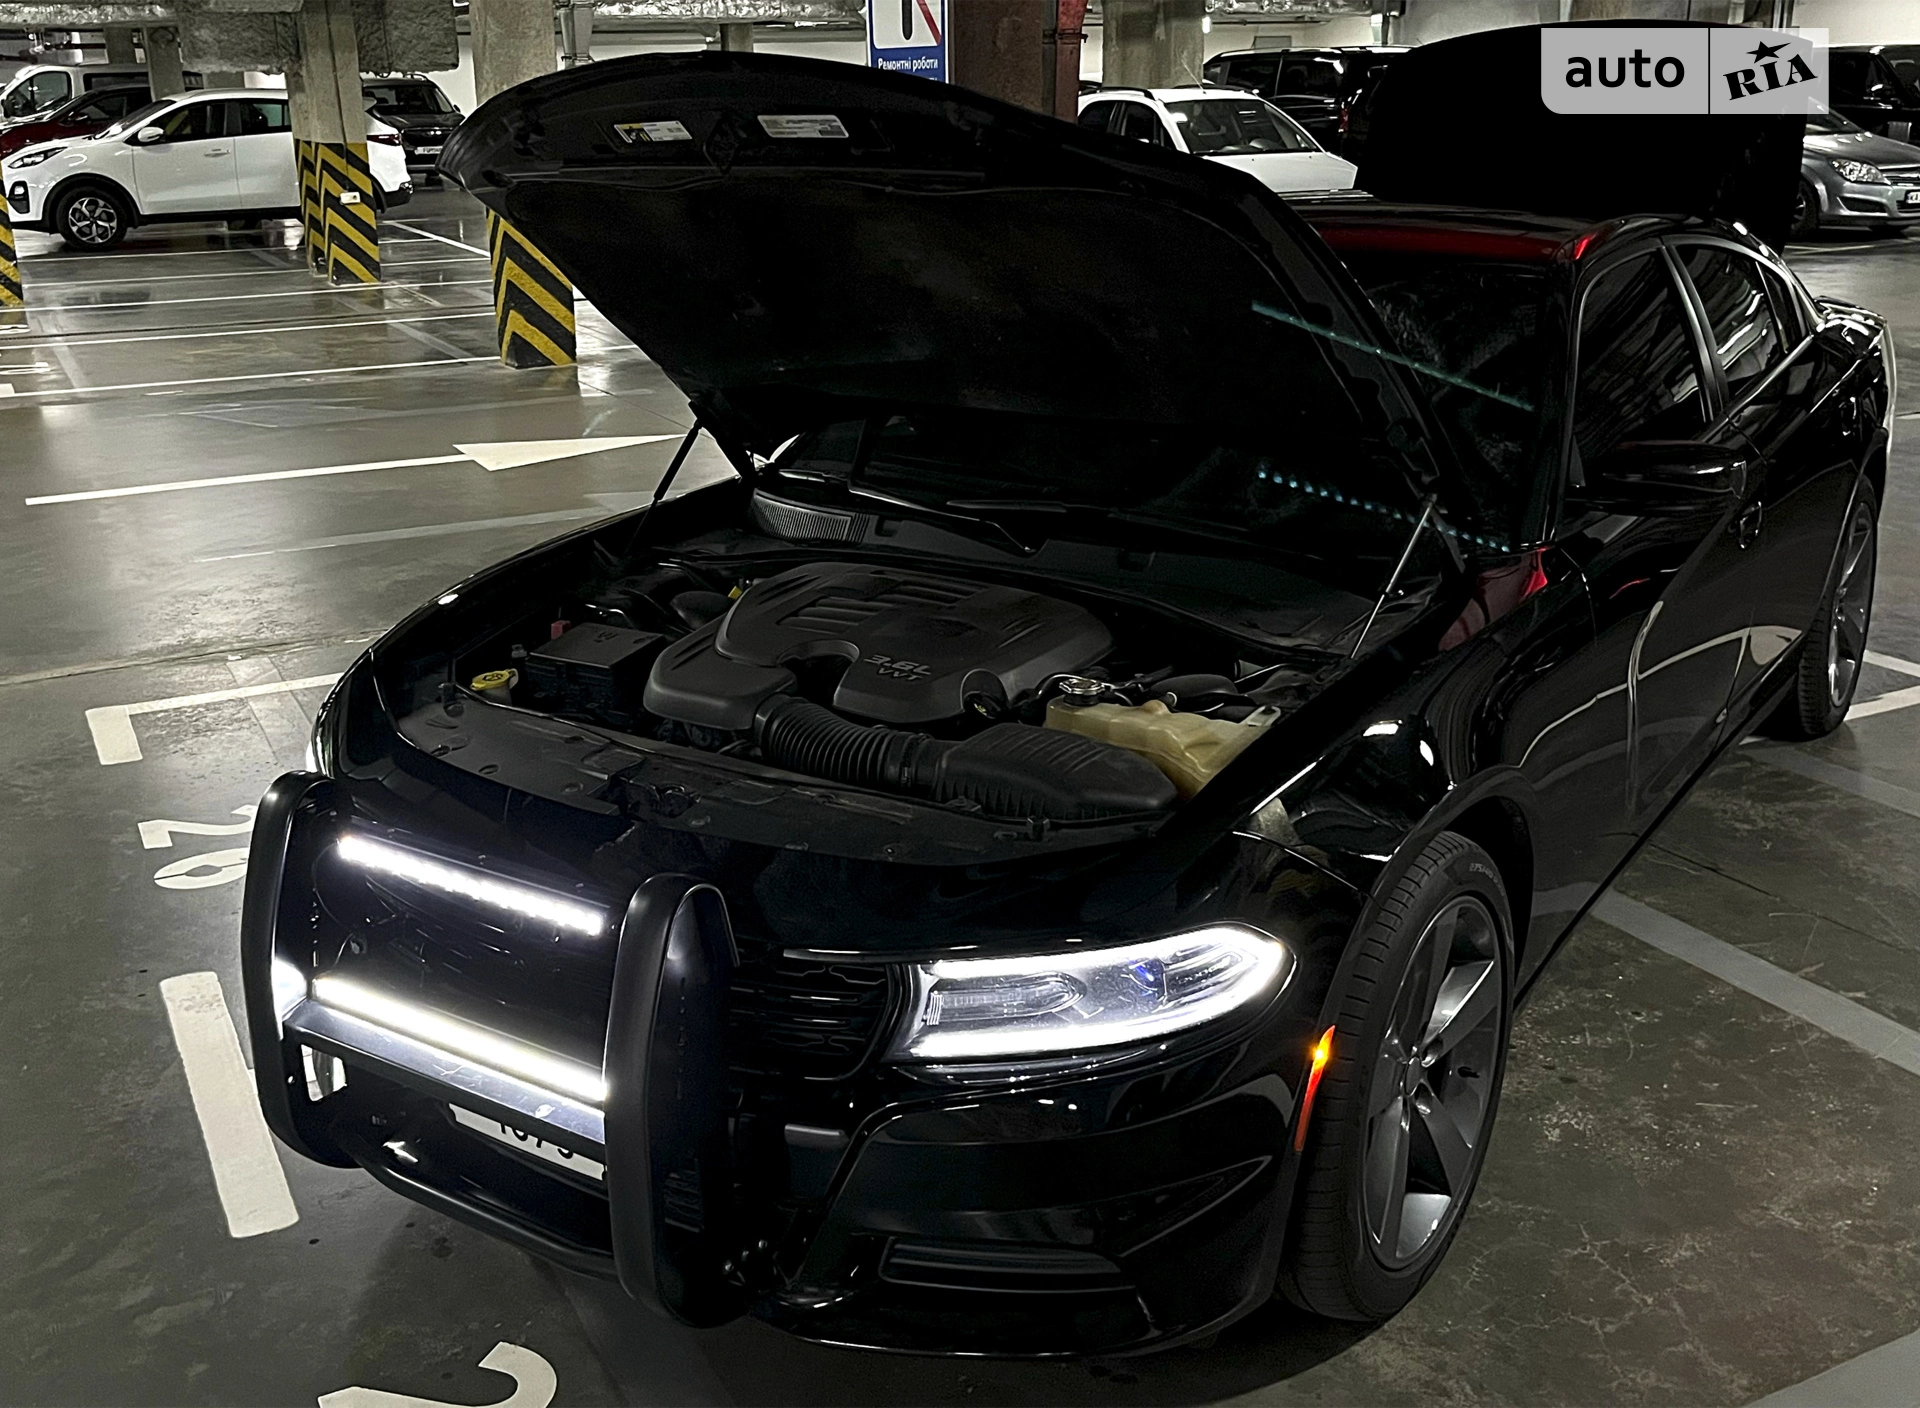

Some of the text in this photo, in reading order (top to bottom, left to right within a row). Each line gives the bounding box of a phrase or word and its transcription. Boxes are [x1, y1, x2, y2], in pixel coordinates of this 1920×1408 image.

[877, 55, 939, 73] Ремонтні роботи
[863, 654, 932, 676] 3.6L
[878, 667, 924, 682] VVT
